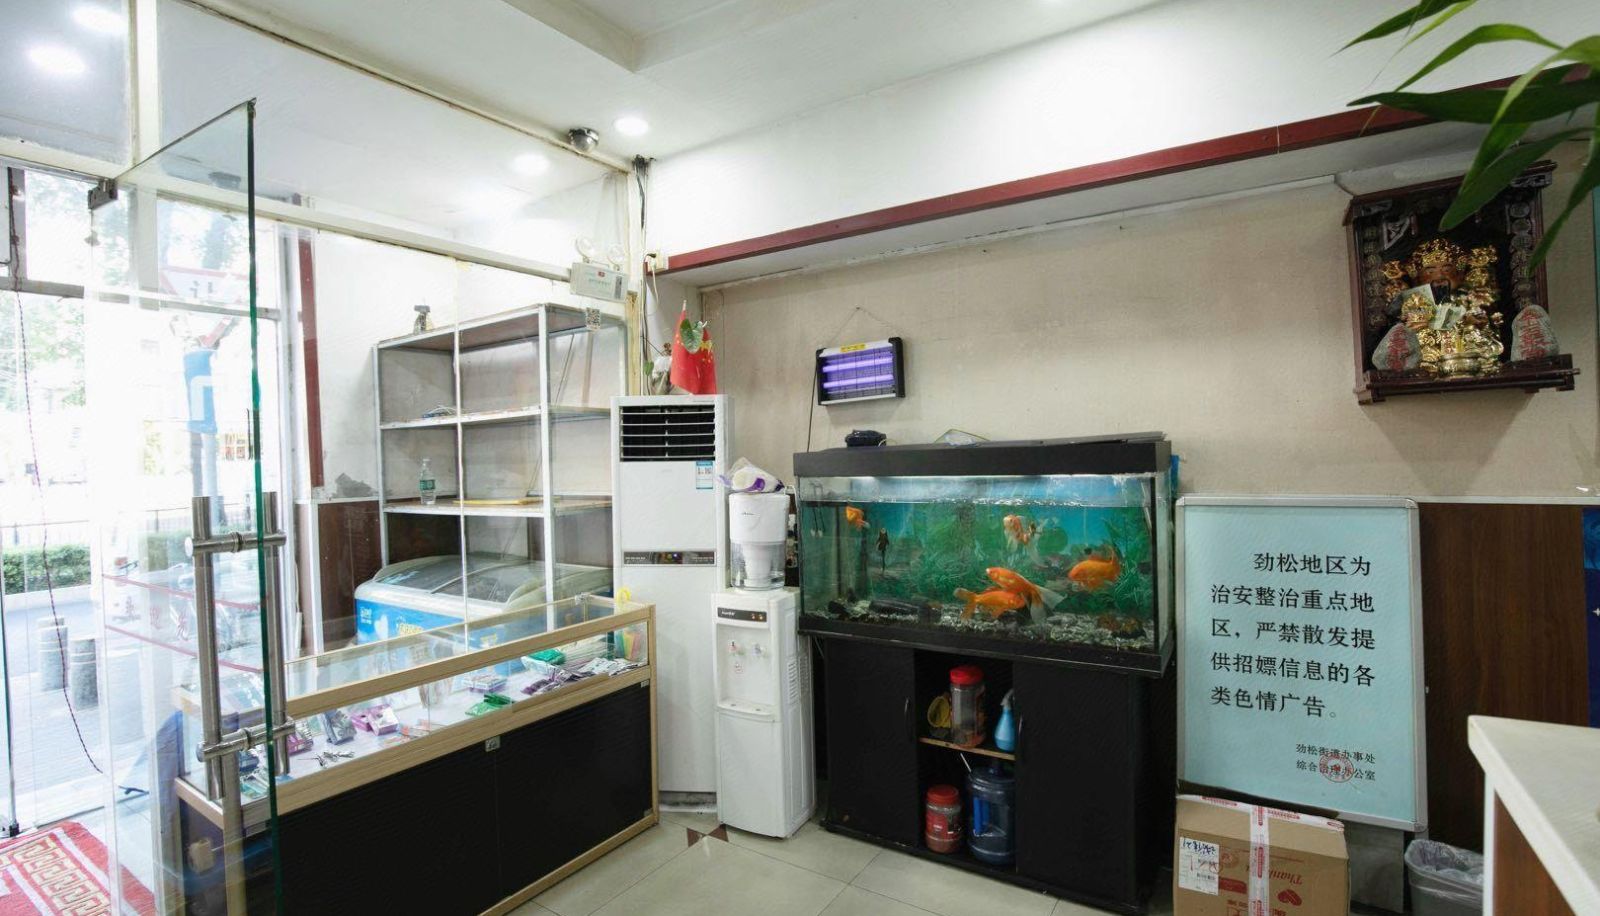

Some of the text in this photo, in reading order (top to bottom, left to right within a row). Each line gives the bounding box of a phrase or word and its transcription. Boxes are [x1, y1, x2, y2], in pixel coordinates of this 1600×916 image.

[1253, 552, 1371, 576] 劲松地区为
[1211, 584, 1375, 613] 治安整治重点地
[1211, 617, 1376, 650] 区，严禁散发提
[1211, 651, 1376, 687] 供招嫖信息的各
[1211, 685, 1337, 718] 类色情广告。
[1296, 743, 1376, 764] 劲松街道办事处
